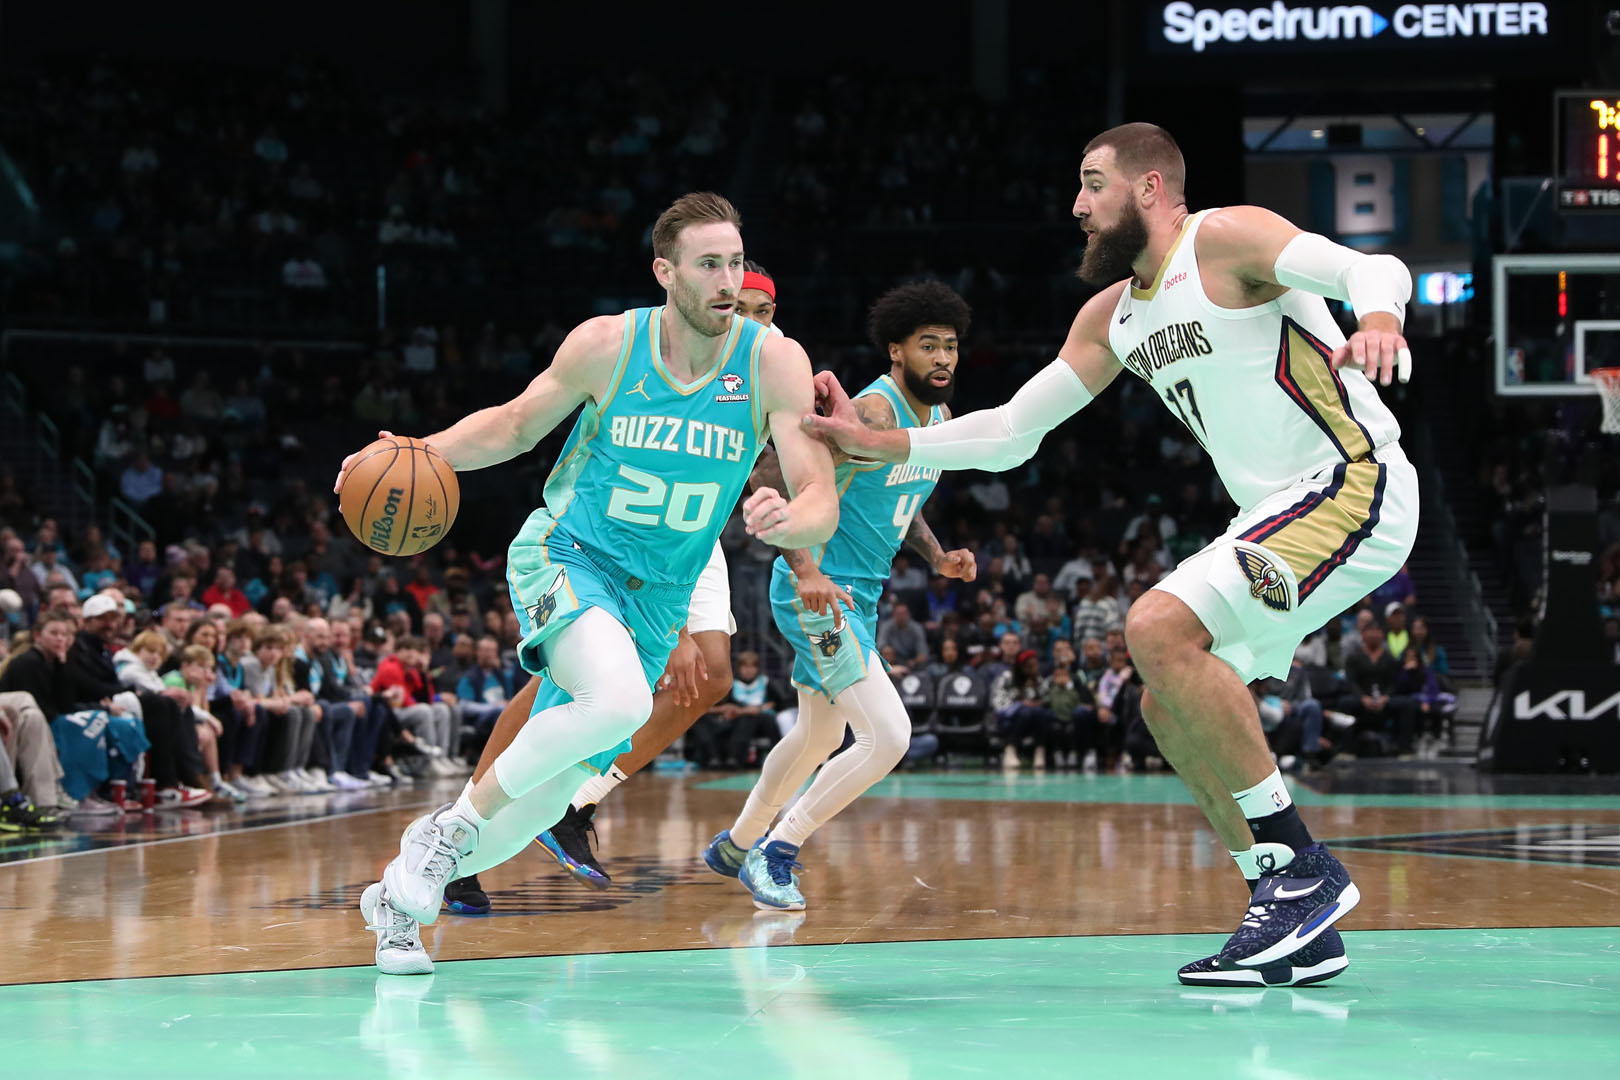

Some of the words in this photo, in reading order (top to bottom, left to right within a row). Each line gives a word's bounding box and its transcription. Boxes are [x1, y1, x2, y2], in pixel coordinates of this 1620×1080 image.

[1163, 1, 1373, 51] Spectrum
[1393, 3, 1548, 38] CENTER
[1590, 100, 1620, 130] 7:
[1164, 272, 1187, 291] ibotta
[1148, 320, 1213, 370] ORLEANS
[715, 394, 750, 402] FEASTABLES
[1165, 378, 1209, 450] 17
[608, 415, 683, 452] BUZZ
[686, 419, 748, 462] CITY
[370, 487, 405, 551] Wilson
[606, 464, 721, 533] 20
[892, 494, 922, 539] 4
